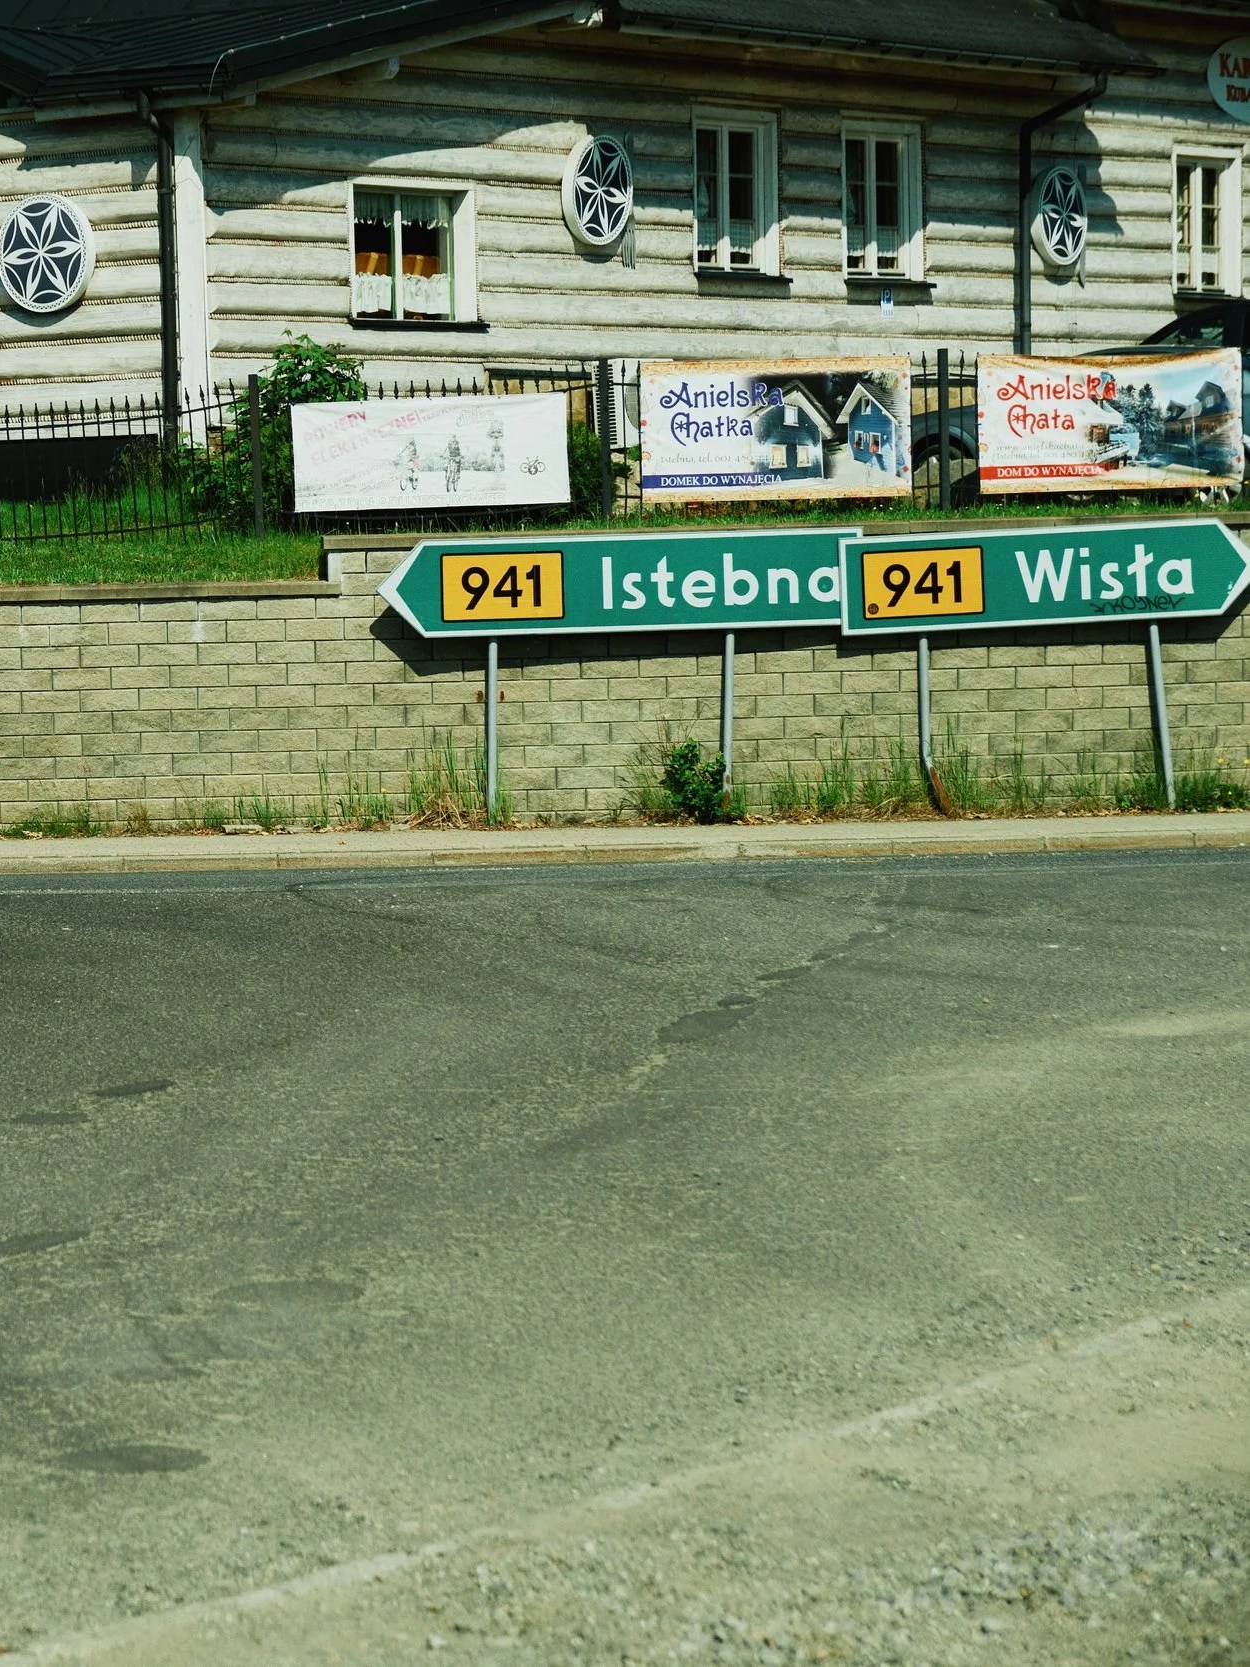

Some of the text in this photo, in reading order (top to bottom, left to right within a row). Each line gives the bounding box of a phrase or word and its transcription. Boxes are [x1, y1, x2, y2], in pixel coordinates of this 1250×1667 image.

[660, 381, 785, 409] Anielska
[997, 374, 1117, 401] Anielska
[670, 412, 754, 446] Chatka
[1007, 404, 1076, 438] Chata
[660, 474, 783, 487] DOMEK DO WYNAJĘCIA
[997, 465, 1102, 478] DOM DO WYNAJĘCIA
[461, 564, 543, 611] 941
[601, 552, 841, 610] Istebna
[882, 560, 963, 608] 941
[1014, 543, 1195, 604] Wisła
